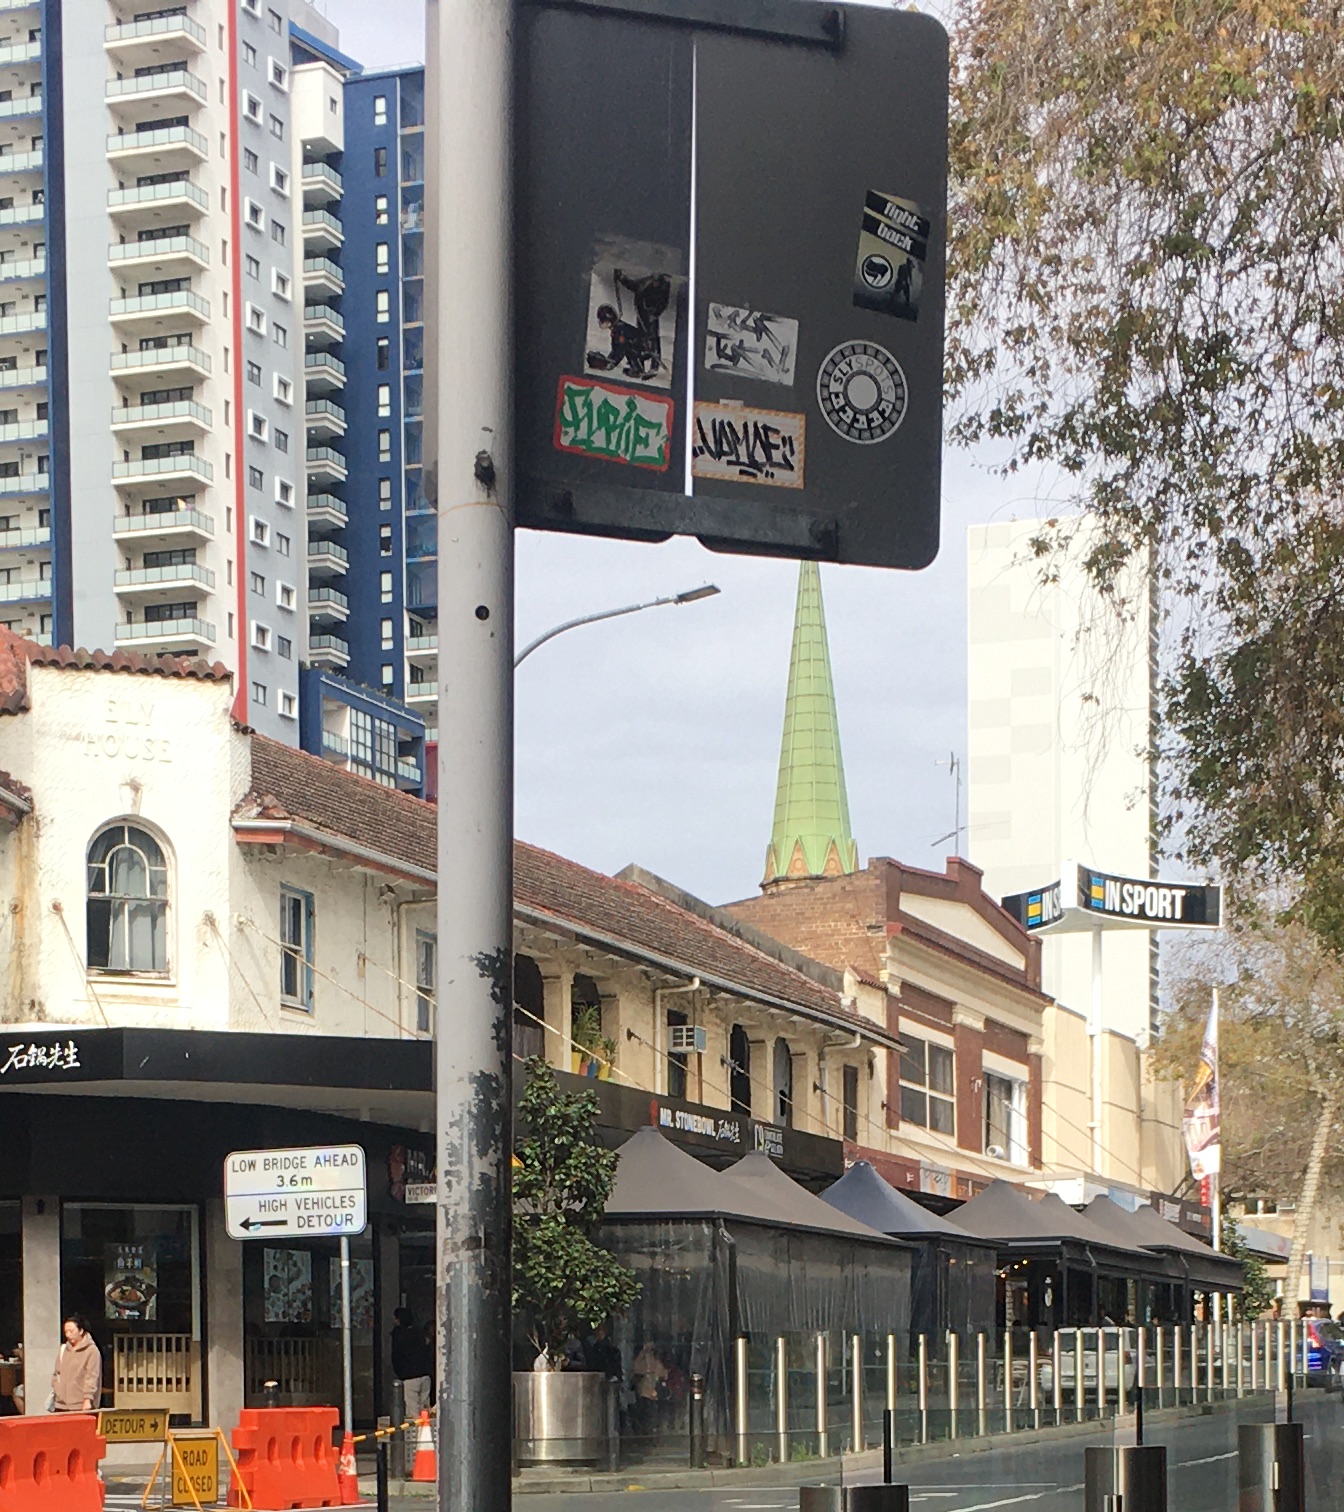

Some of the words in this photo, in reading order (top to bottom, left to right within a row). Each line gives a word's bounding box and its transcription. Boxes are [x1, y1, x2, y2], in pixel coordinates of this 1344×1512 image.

[877, 222, 914, 251] back
[83, 730, 173, 764] HOUSE
[1105, 878, 1121, 913] IN
[1121, 883, 1187, 920] SPORT
[0, 1038, 82, 1075] 石锅先生
[232, 1158, 257, 1173] LOW
[263, 1156, 307, 1171] BRIDGE
[314, 1153, 358, 1168] AHEAD
[258, 1198, 288, 1213] HIGH
[294, 1195, 356, 1211] VEHICLES
[296, 1213, 354, 1229] DETOUR
[105, 1418, 145, 1434] DETOUR
[182, 1449, 208, 1467] ROAD
